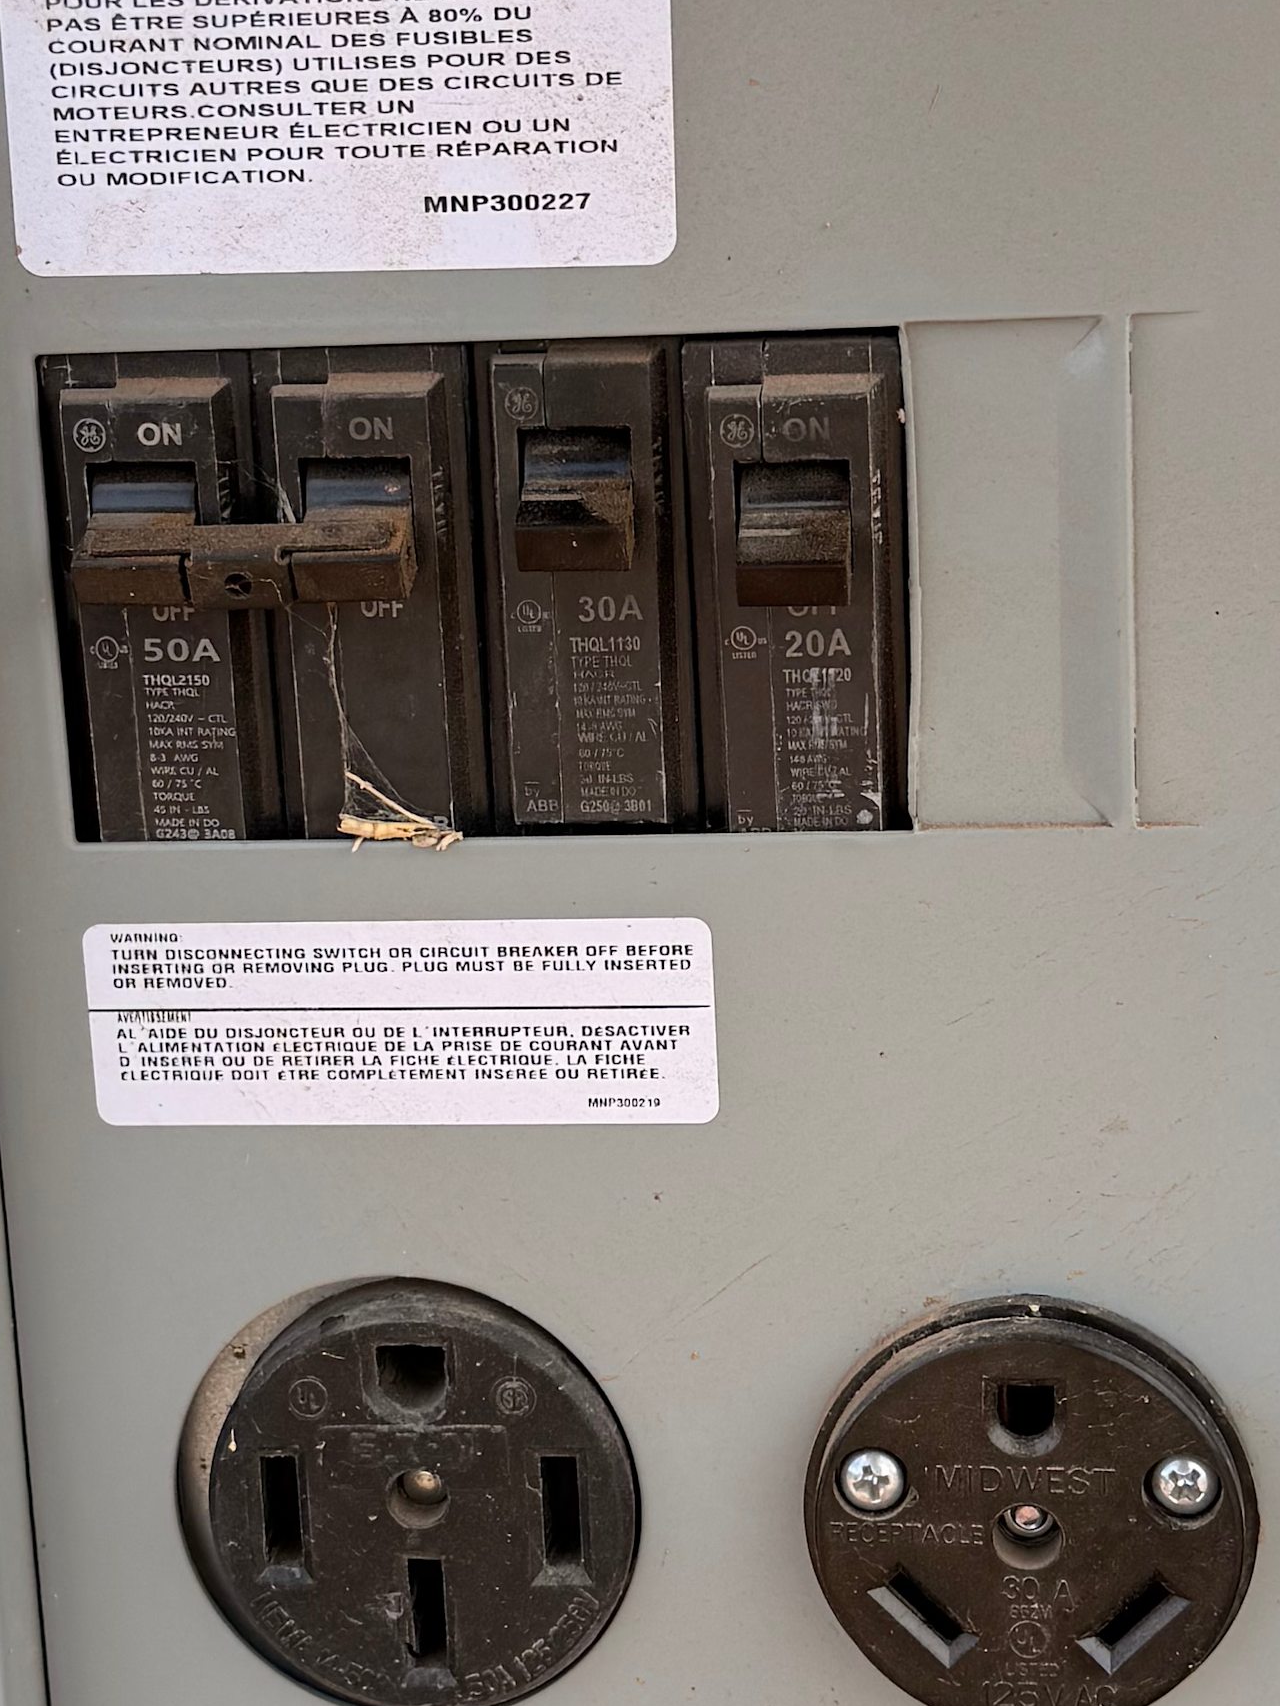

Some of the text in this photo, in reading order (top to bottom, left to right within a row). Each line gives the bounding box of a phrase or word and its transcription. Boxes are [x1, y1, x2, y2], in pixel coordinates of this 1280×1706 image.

[46, 17, 100, 32] PAS
[192, 10, 390, 28] SUPÉRIEURES
[398, 5, 419, 24] À
[493, 5, 531, 20] DU
[47, 28, 532, 54] COURANT NOMINAL DES FUSIBLES
[49, 50, 571, 80] (DISJONCTEURS) UTILISES POUR DES
[50, 70, 622, 99] CIRCUITS AUTRES QUE DES CIRCUITS DE
[377, 99, 414, 114] UN
[54, 117, 569, 143] ENTREPRENEUR ÉLECTRICIEN OU UN
[56, 138, 617, 165] ÉLECTRICIEN POUR TOUTE RÉPARATION
[57, 168, 312, 186] OU MODIFICATION.
[423, 192, 590, 213] MNP300227
[138, 423, 182, 446] ON
[349, 417, 393, 440] ON
[782, 418, 830, 442] ON
[577, 595, 644, 622] 30A
[144, 638, 221, 662] 50A
[569, 636, 641, 652] THQL1130
[785, 628, 852, 658] 20A
[143, 674, 211, 687] THQL2150
[198, 727, 237, 737] RATING
[526, 799, 559, 812] ABB
[110, 944, 693, 960] TURN DISCONNECTING SWITCH OR CIRCUIT BREAKER OFF BEFORE
[112, 958, 690, 974] INSERTING OR REMOVING PLUG MUST BE FULLY INSERTED
[112, 977, 136, 988] OR
[225, 1026, 346, 1039] DISJONCTEUR
[441, 1038, 677, 1051] PRISE COURANT AVANT
[281, 1053, 645, 1066] RETIRER FICHE FICHE
[230, 1069, 269, 1080] DOIT
[935, 1464, 1116, 1495] MIDWEST
[830, 1521, 985, 1546] RECEPTACLE
[1002, 1574, 1040, 1602] 30
